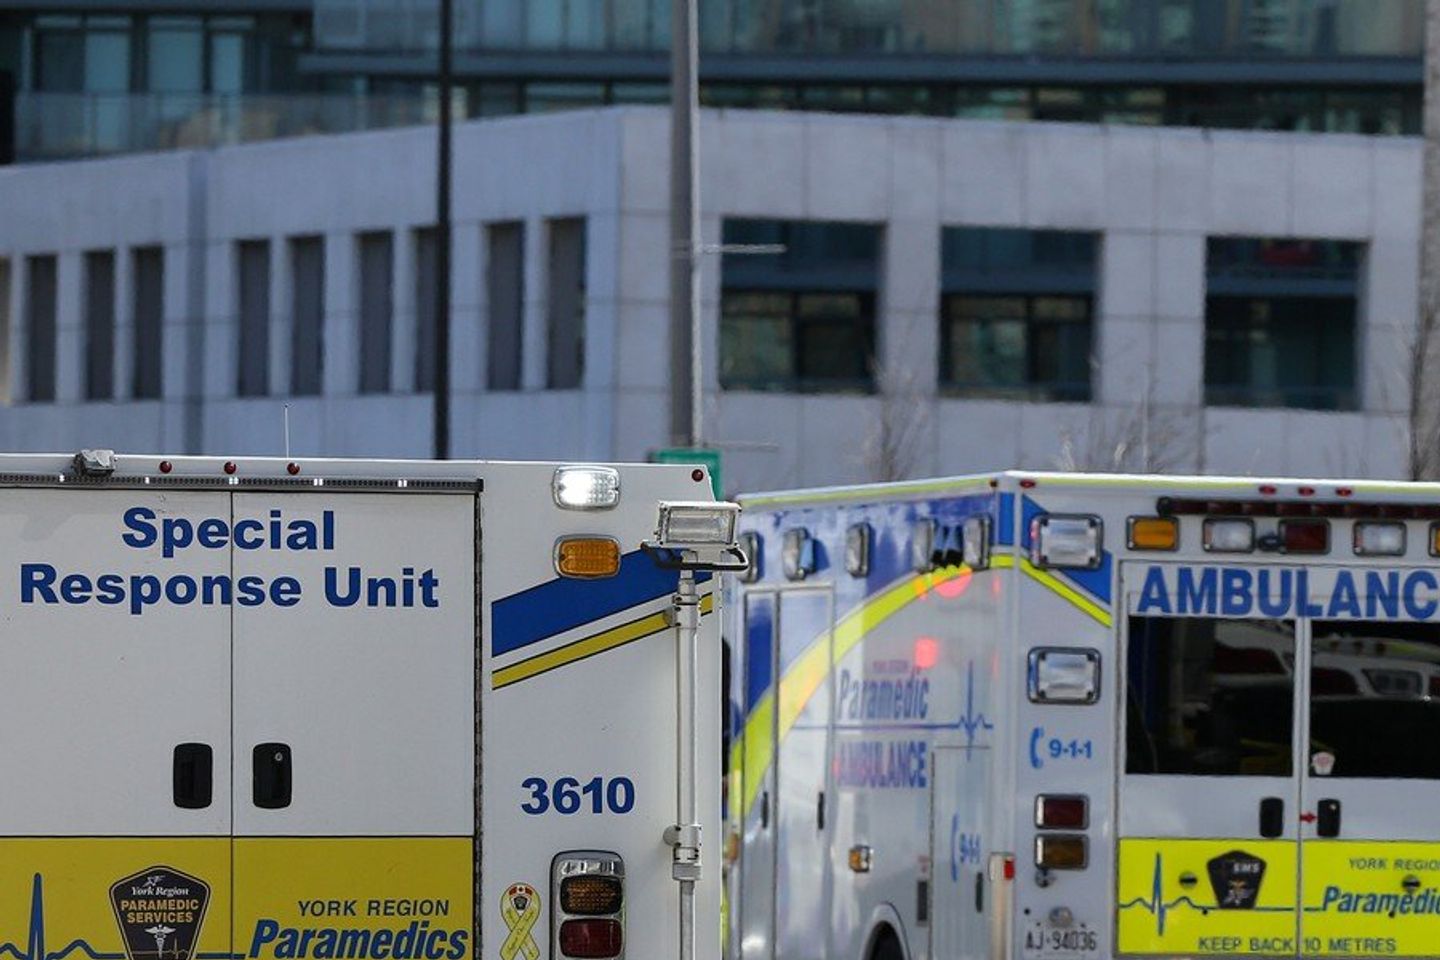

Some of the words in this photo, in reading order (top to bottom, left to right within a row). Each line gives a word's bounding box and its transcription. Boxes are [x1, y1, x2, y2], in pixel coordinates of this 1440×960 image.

[122, 507, 334, 558] Special
[20, 563, 301, 614] Response
[324, 566, 439, 608] Unit
[1049, 738, 1092, 759] 9-1-1
[521, 778, 636, 815] 3610
[1349, 858, 1387, 871] YORK
[132, 886, 155, 897] York
[155, 886, 190, 898] Region
[121, 899, 200, 911] PARAMEDIC
[298, 899, 358, 916] YORK
[367, 899, 450, 916] REGION
[126, 911, 194, 924] SERVICES
[249, 918, 469, 960] Paramedics
[1199, 936, 1241, 951] KEEP
[1250, 937, 1294, 951] BACK
[1304, 937, 1321, 951] 10
[1328, 937, 1396, 952] METRES
